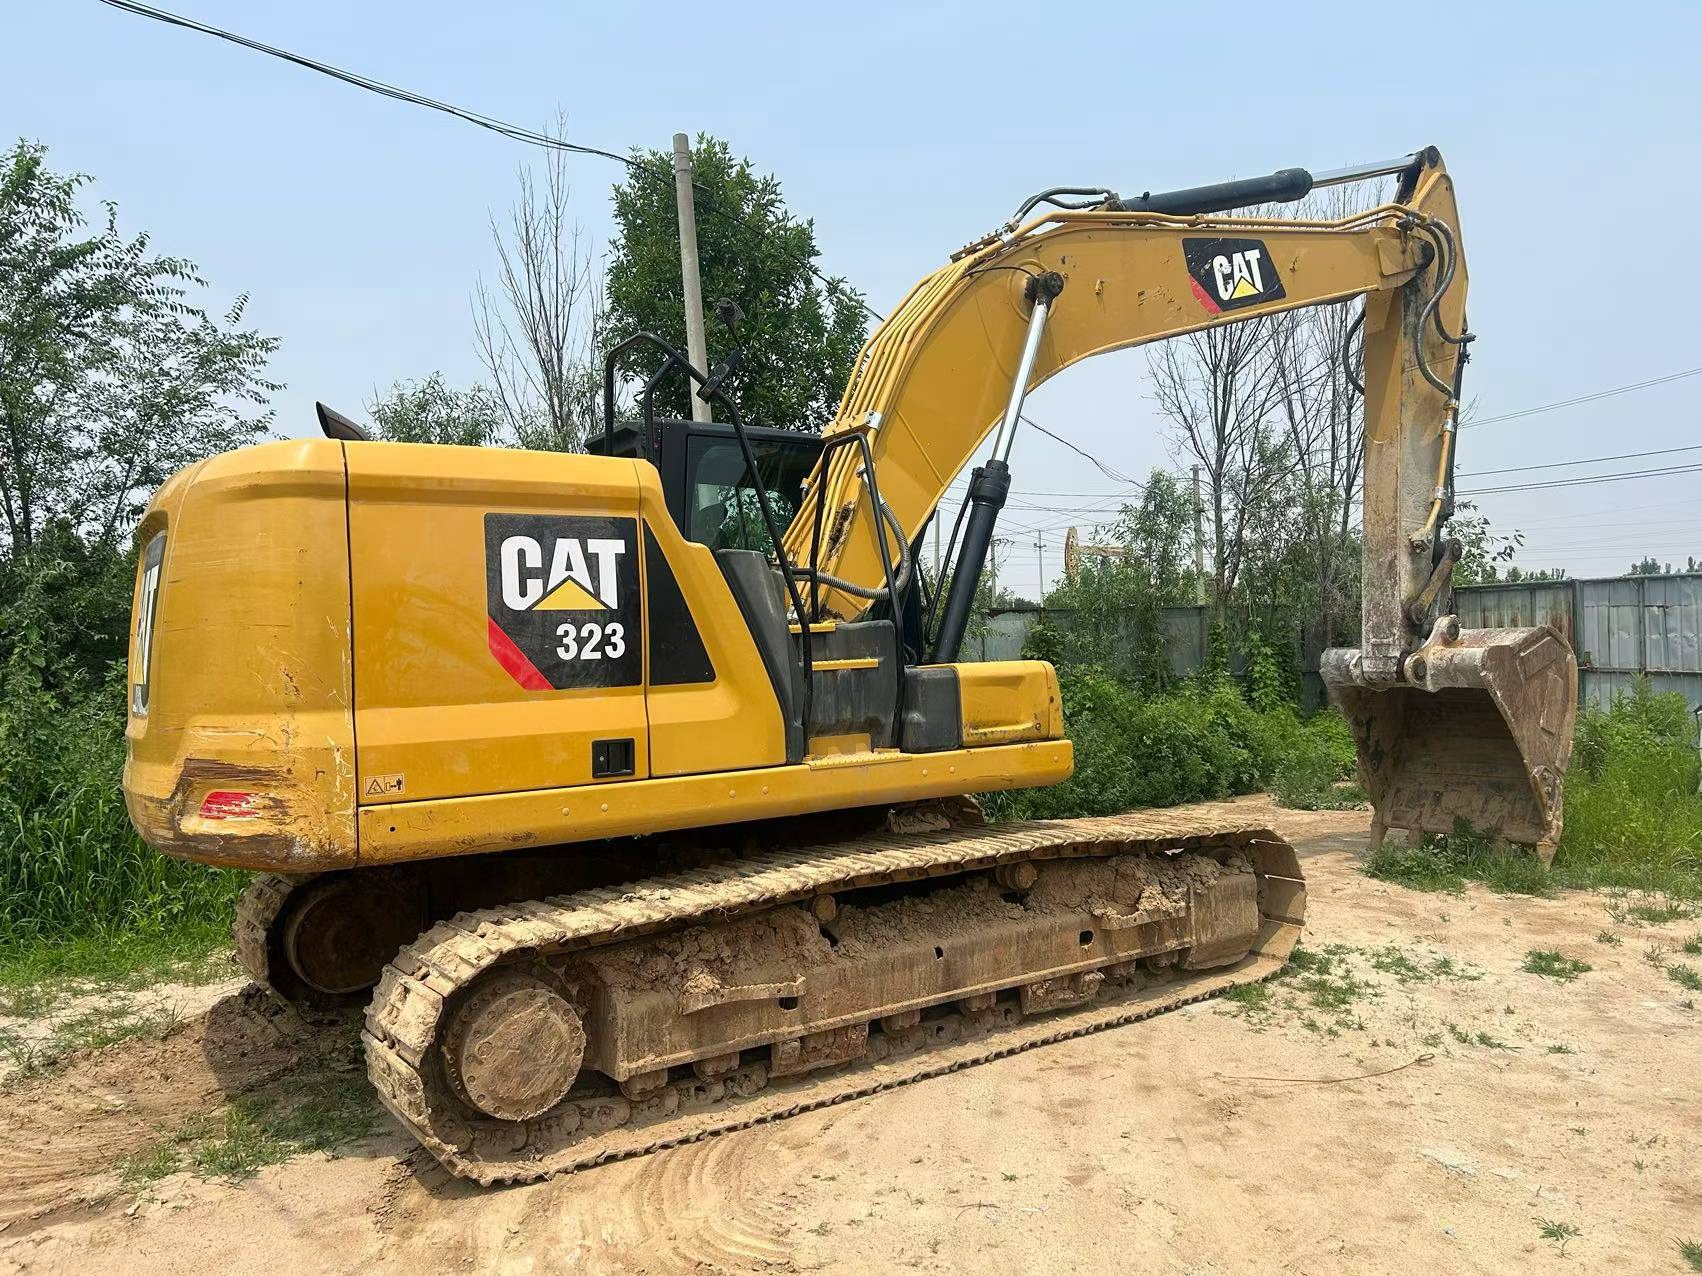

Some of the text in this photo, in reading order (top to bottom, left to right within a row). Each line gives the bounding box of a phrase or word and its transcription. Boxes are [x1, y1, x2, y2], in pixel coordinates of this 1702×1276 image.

[1212, 248, 1264, 301] CAT
[500, 535, 626, 611] CAT
[556, 622, 626, 661] 323
